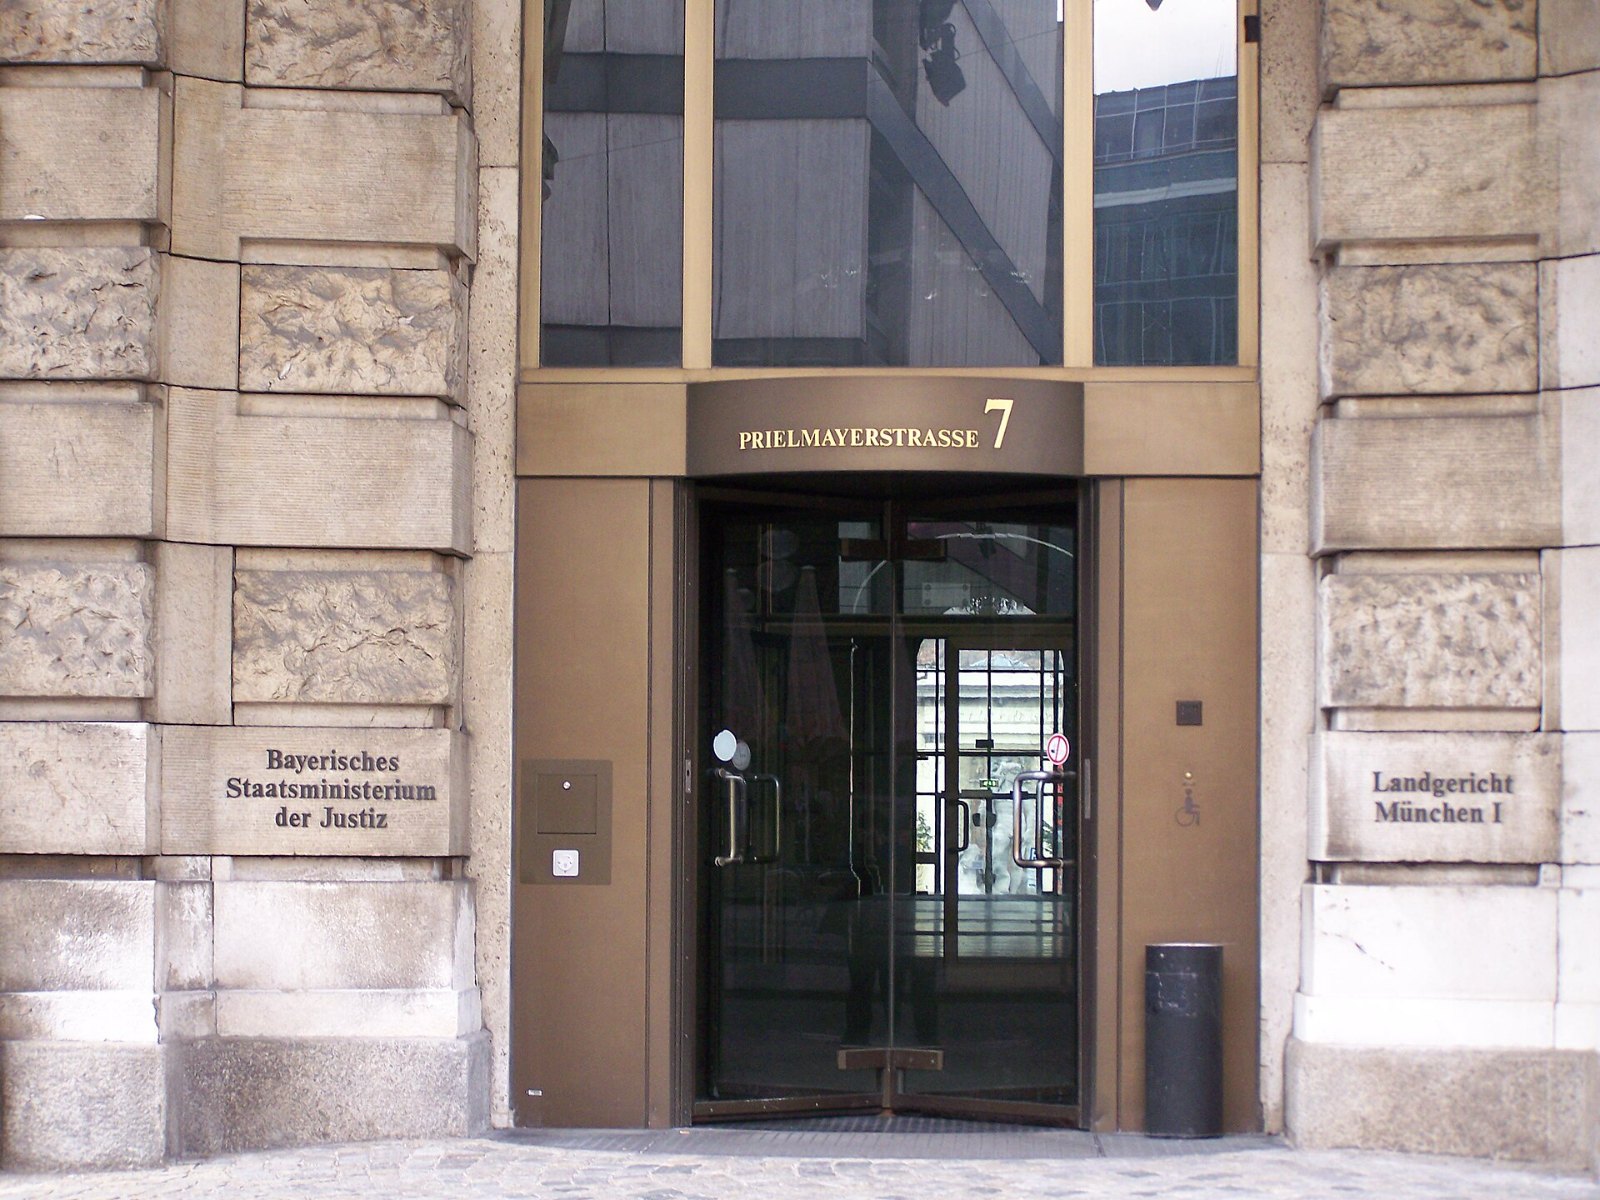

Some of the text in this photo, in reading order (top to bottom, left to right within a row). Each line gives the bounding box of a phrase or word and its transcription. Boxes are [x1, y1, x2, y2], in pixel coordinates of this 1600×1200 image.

[739, 398, 1014, 450] PRIELMAYERSTRASSE 7
[266, 749, 400, 774] Bayerisches
[226, 777, 437, 801] Staatsministerium
[1373, 771, 1514, 797] Landgericht
[275, 806, 388, 829] der Justiz
[1375, 801, 1503, 823] München I
